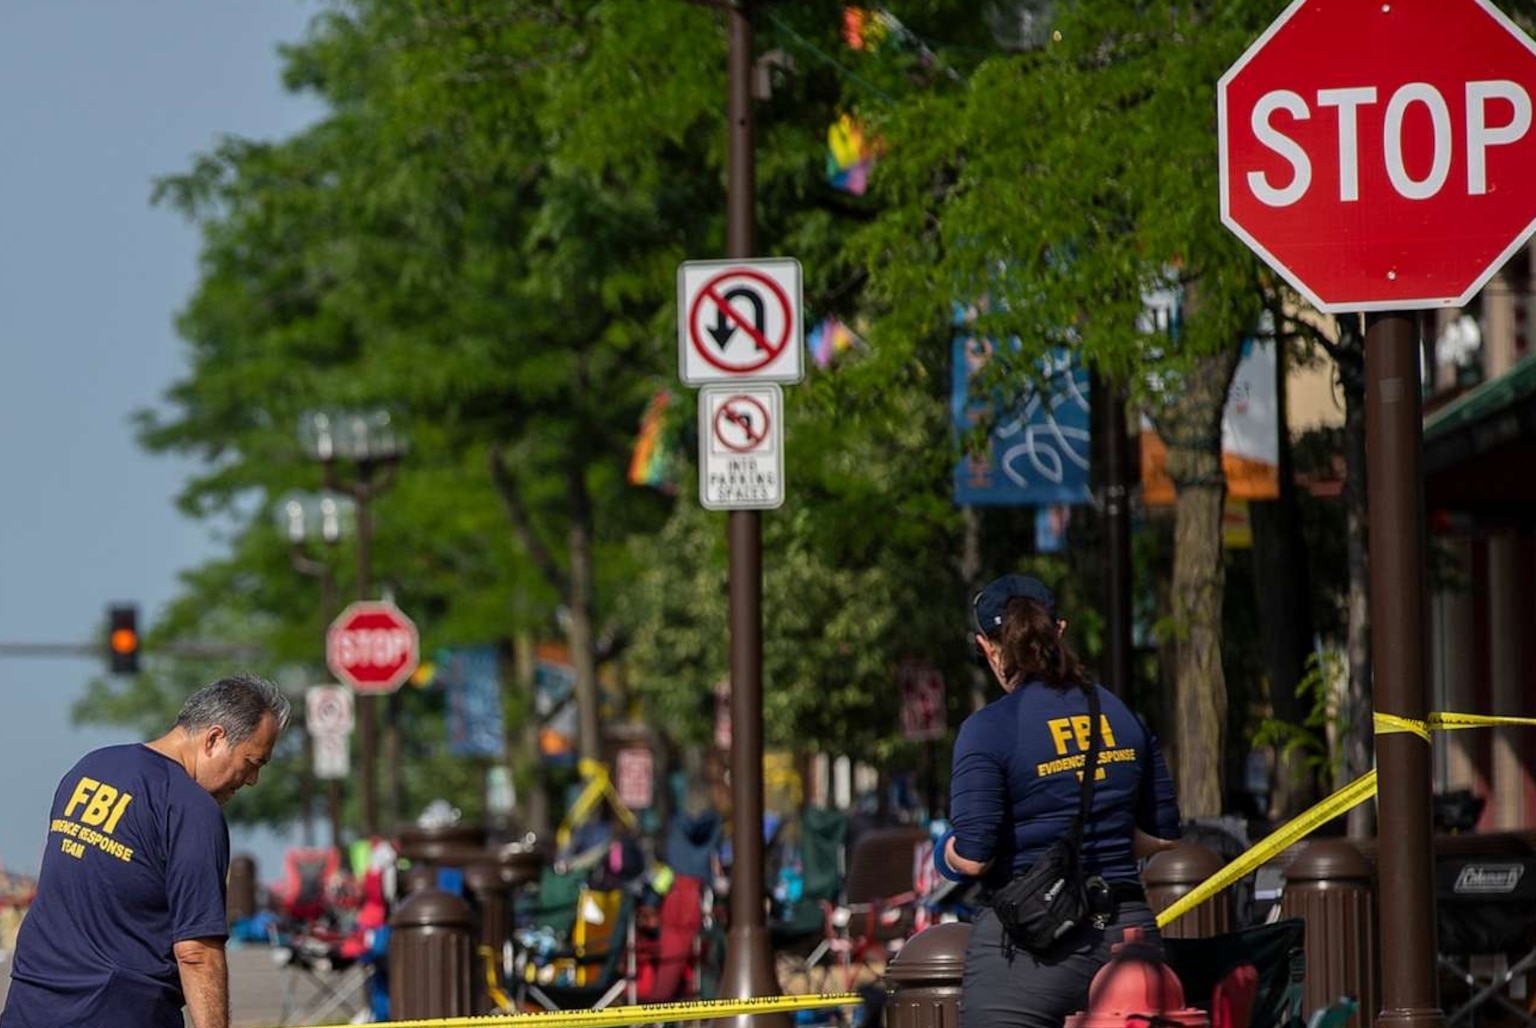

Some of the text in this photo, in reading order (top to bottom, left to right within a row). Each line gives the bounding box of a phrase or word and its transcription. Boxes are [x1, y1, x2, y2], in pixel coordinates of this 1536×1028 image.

[1247, 80, 1533, 207] STOP
[338, 628, 409, 668] STOP
[64, 777, 133, 834] FBI
[61, 838, 86, 859] TEAM
[78, 827, 134, 863] RESPONSE
